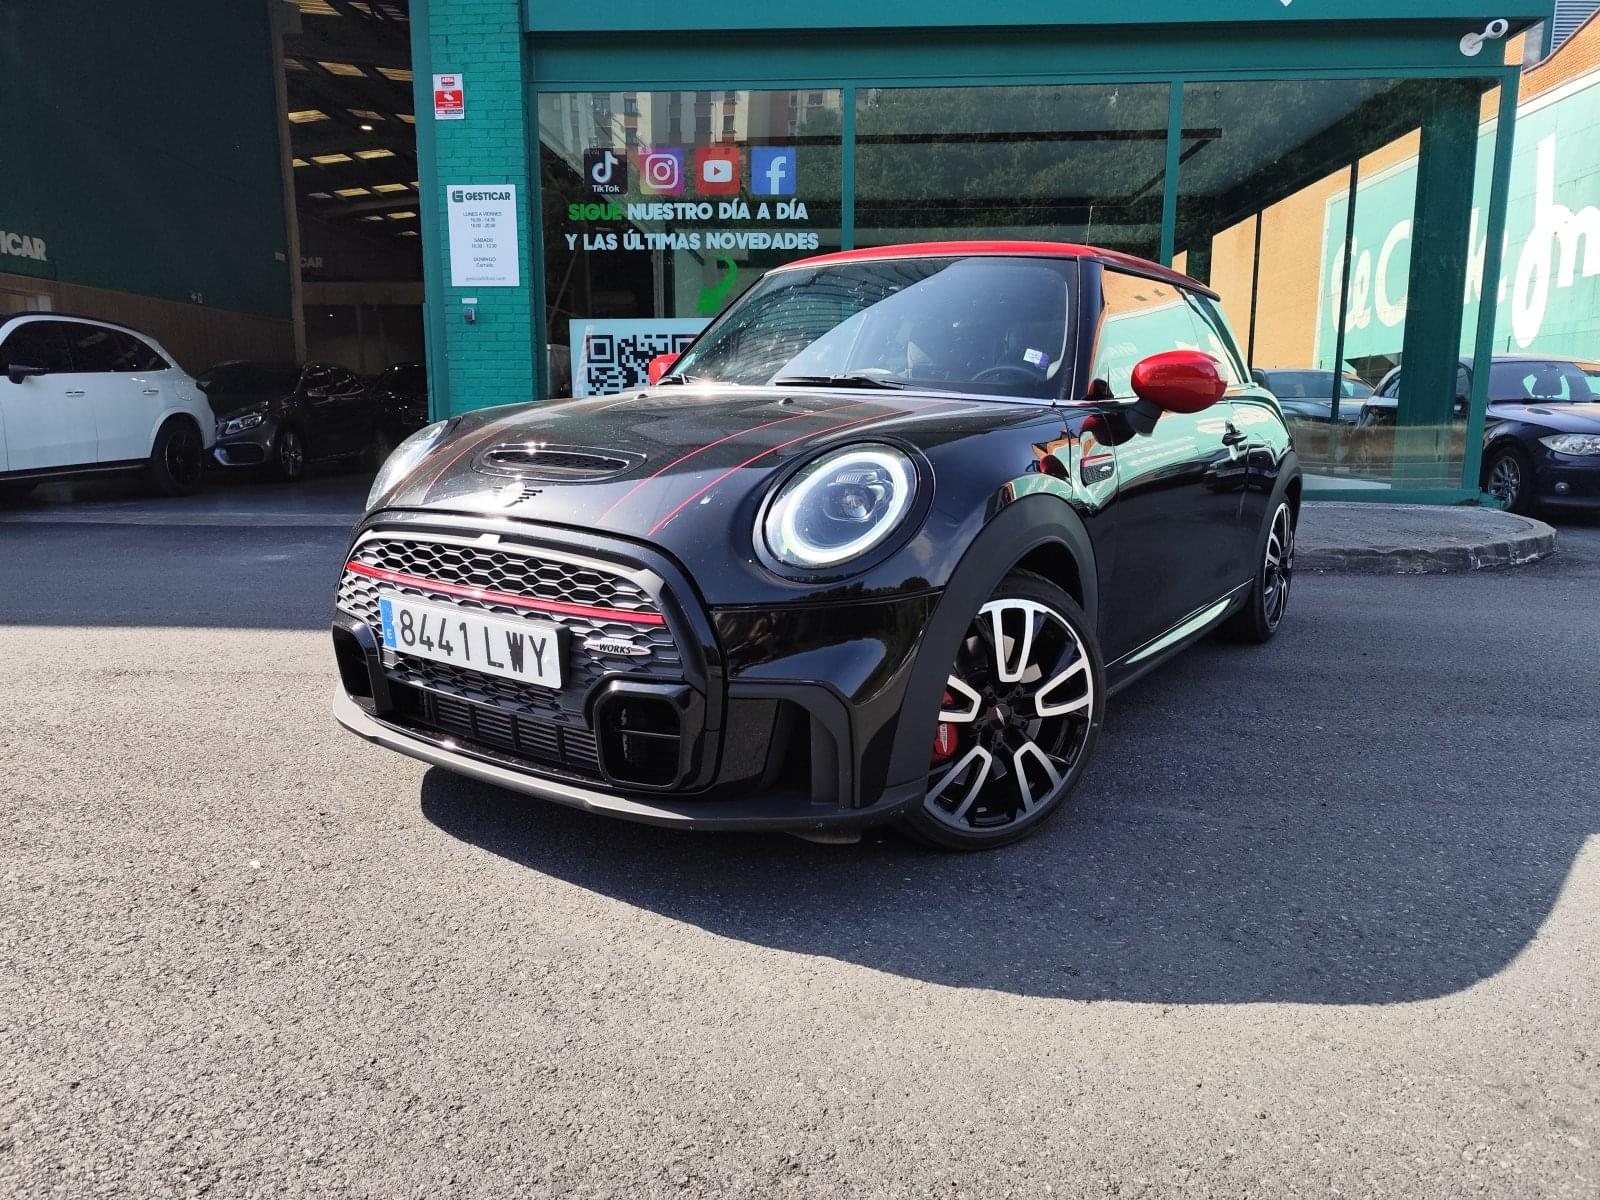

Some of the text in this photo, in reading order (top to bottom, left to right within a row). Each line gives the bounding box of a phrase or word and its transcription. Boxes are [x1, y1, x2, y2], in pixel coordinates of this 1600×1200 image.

[465, 191, 511, 201] GESTICAR
[592, 184, 620, 193] TikTok
[568, 198, 809, 221] SIGUE NUESTRO DÍA A DÍA
[564, 228, 819, 251] Y LAS ÚLTIMAS NOVEDADES
[400, 609, 547, 678] 8441 LWY
[600, 643, 631, 654] WORKS
